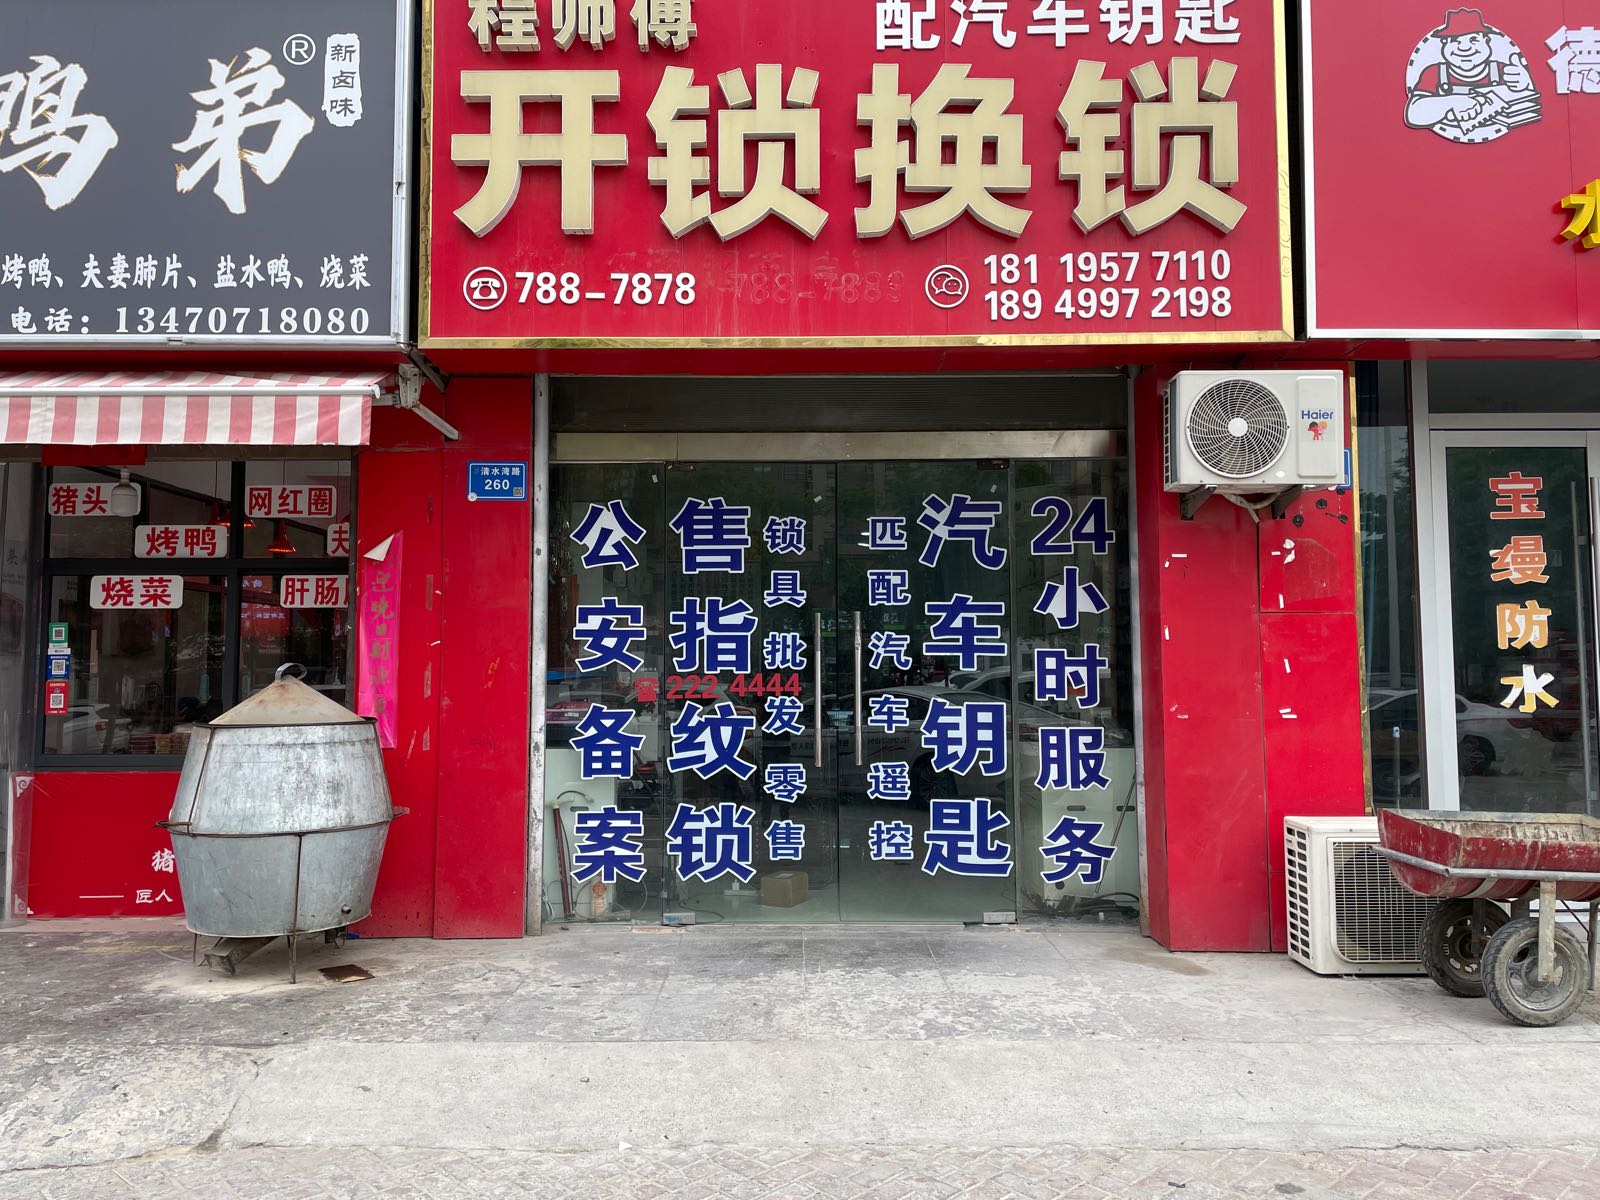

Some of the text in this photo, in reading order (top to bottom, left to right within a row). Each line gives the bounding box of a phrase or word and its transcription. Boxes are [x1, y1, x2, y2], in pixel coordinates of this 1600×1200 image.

[876, 0, 1241, 50] 配汽车钥匙
[330, 43, 357, 117] 新卤味
[451, 56, 1248, 242] 开锁换锁
[984, 249, 1231, 285] 181 1957 7110
[515, 272, 696, 305] 788-7878
[984, 286, 1232, 321] 189 4997 2198
[1302, 410, 1334, 420] Haier
[481, 467, 520, 476] 清水湾路
[484, 479, 510, 490] 260
[248, 487, 333, 516] 网红圈
[146, 527, 217, 557] 烤鸭
[101, 577, 172, 607] 烧菜
[283, 577, 349, 606] 肝肠
[1488, 471, 1560, 713] 宝缦防水
[570, 500, 647, 883] 公安备案
[666, 673, 801, 700] 222 4444
[666, 497, 758, 883] 售指纹锁
[763, 516, 807, 861] 锁具批发零售
[867, 516, 913, 861] 匹配汽车遥控
[917, 493, 1014, 877] 汽车钥匙
[1031, 496, 1117, 885] 24小时服务
[136, 888, 174, 904] 匠人
